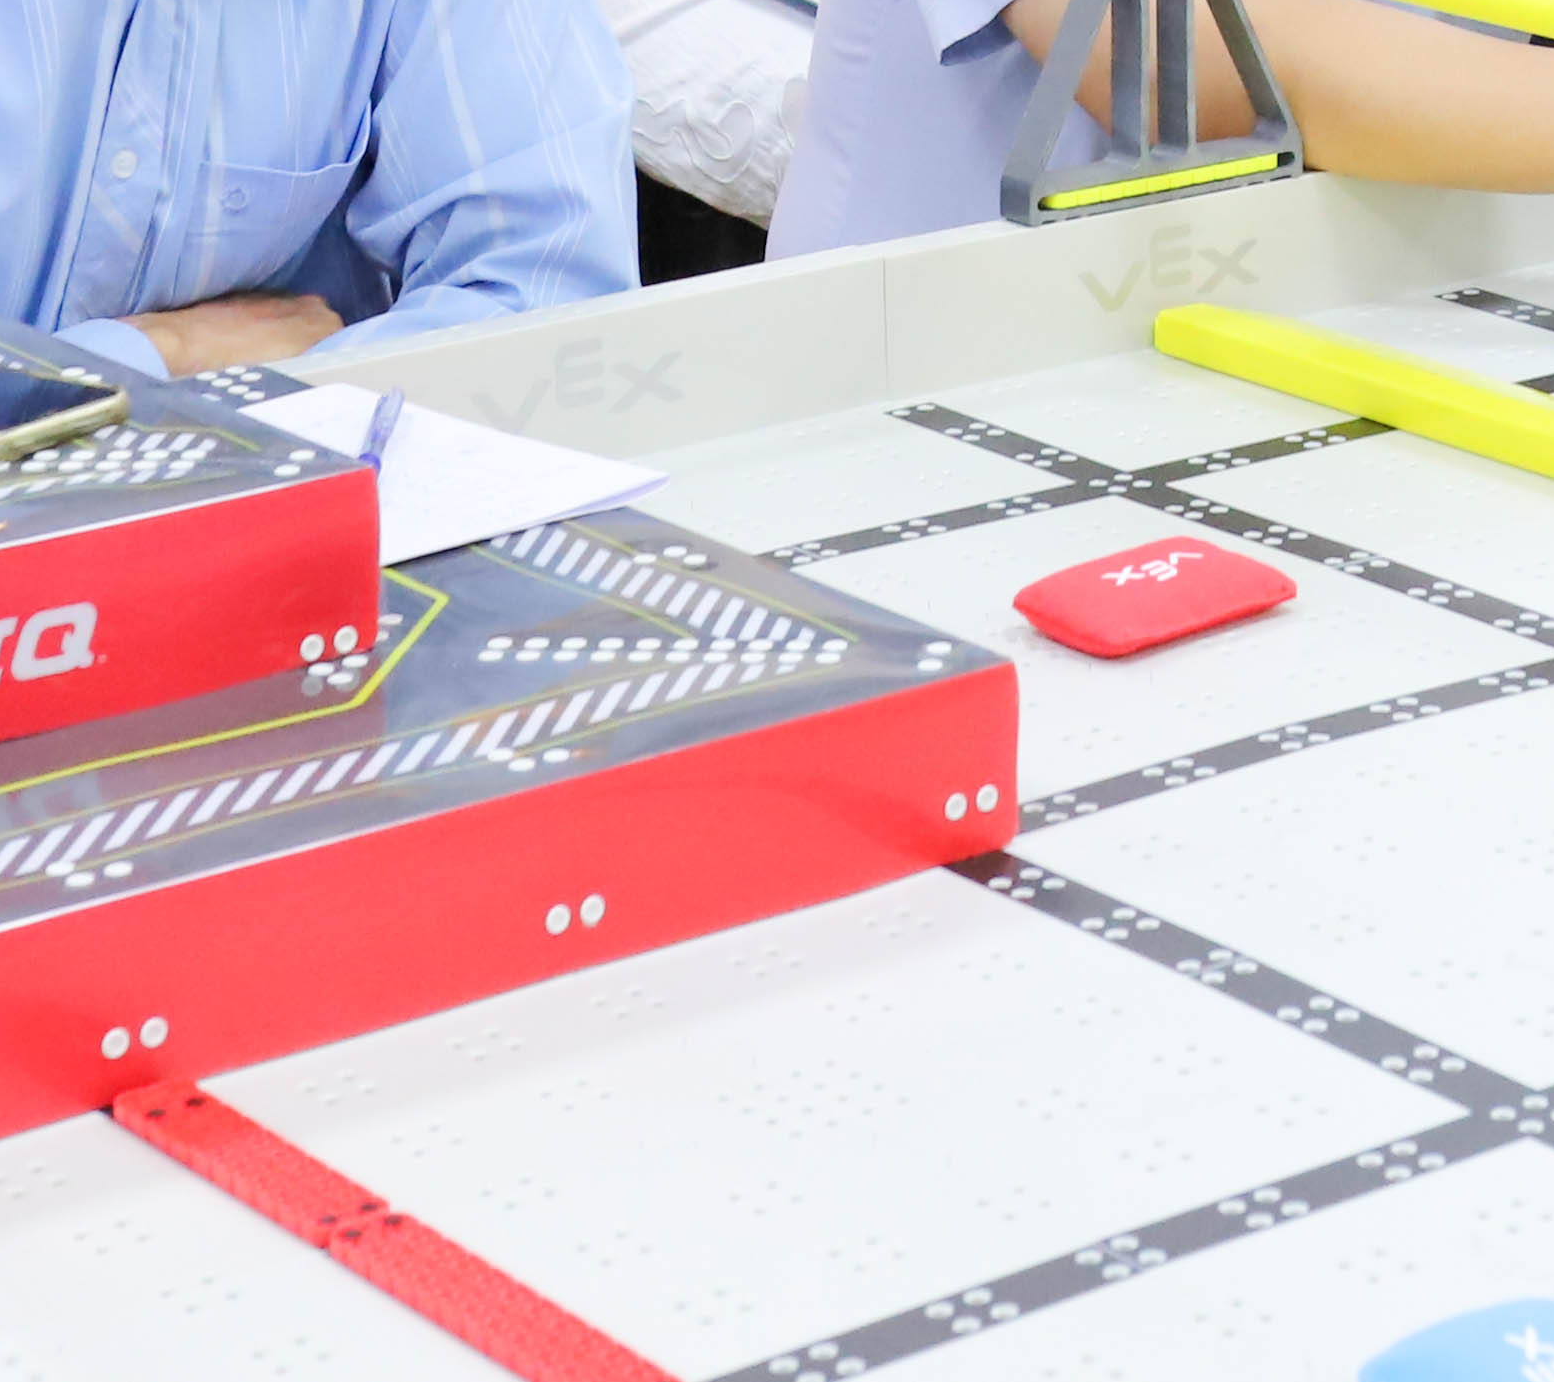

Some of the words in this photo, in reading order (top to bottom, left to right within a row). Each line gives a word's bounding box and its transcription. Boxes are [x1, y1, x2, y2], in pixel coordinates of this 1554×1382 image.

[1078, 223, 1260, 312] VEX
[471, 336, 686, 436] VEX
[1100, 550, 1205, 587] VEX
